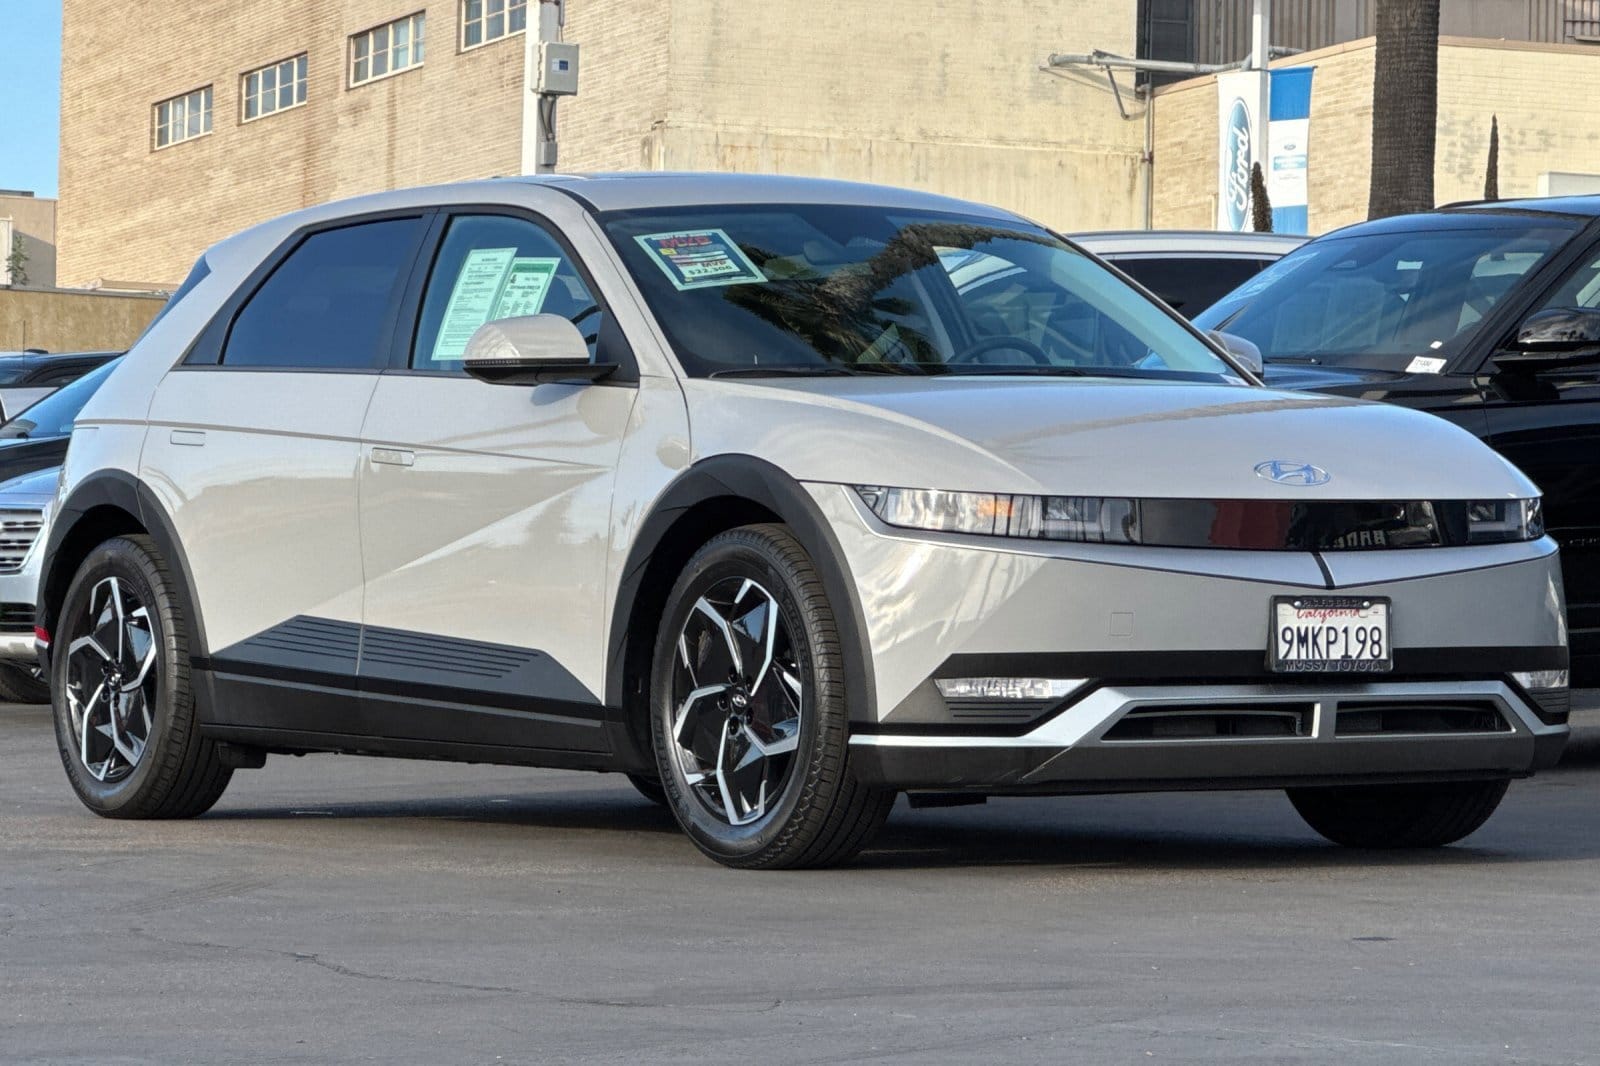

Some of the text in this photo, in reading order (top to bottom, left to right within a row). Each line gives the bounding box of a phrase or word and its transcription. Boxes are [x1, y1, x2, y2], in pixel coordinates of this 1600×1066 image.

[1227, 126, 1249, 212] Ford
[1296, 607, 1363, 624] California
[1281, 625, 1382, 660] 9MKP198
[1285, 660, 1384, 672] MOSSY TOYOTA
